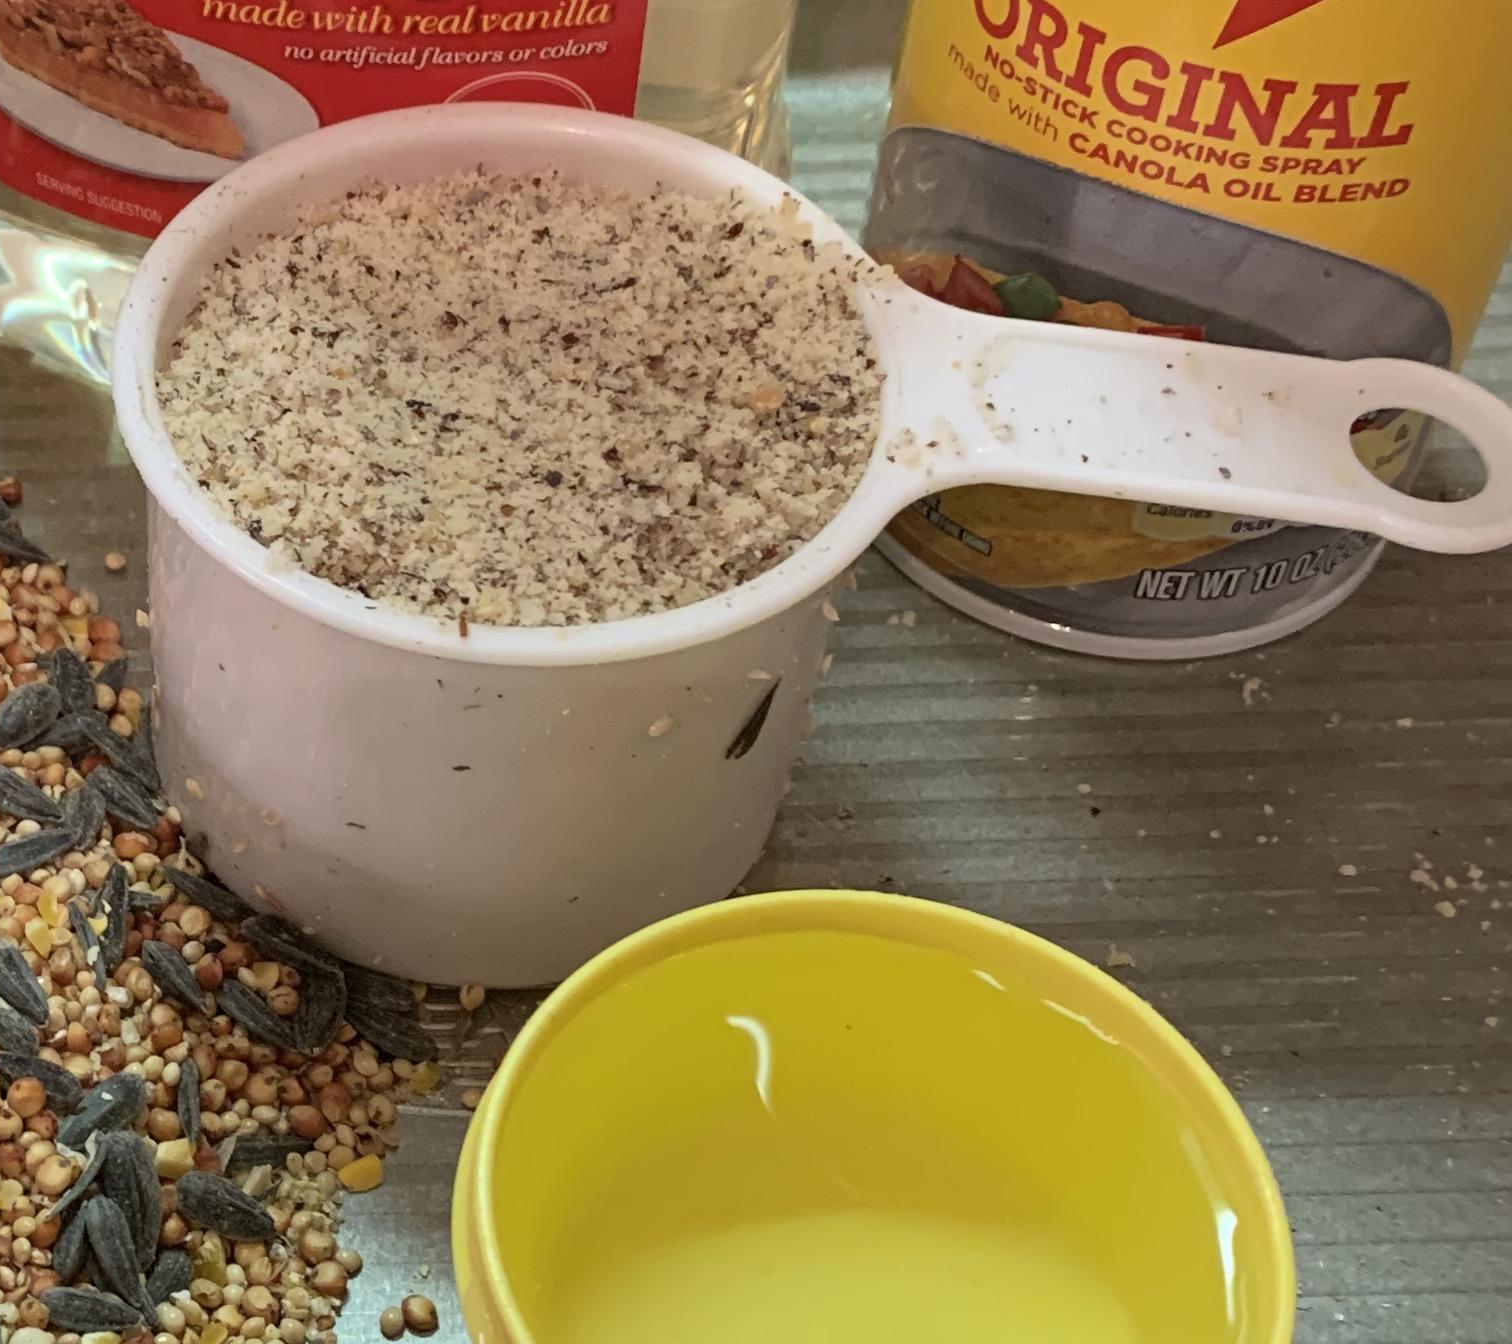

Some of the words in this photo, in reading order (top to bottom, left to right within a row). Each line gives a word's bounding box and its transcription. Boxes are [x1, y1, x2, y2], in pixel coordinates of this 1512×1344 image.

[312, 5, 392, 34] with
[402, 7, 476, 35] real
[284, 44, 314, 61] no
[319, 43, 417, 68] artificial
[415, 44, 503, 70] flavors
[509, 47, 534, 63] or
[540, 39, 608, 61] colors
[948, 43, 1001, 104] made
[1007, 95, 1059, 143] with
[1068, 132, 1210, 195] CANOLA
[1223, 178, 1282, 203] OIL
[1292, 177, 1411, 204] BLEND
[984, 45, 1097, 130] NO-STICK
[1106, 118, 1251, 172] COOKING
[1258, 156, 1367, 177] SPRAY
[36, 172, 84, 201] SERVING
[87, 191, 162, 223] SUGGESTION
[1136, 568, 1196, 600] NET
[1198, 567, 1246, 600] WT
[1251, 560, 1287, 594] 10
